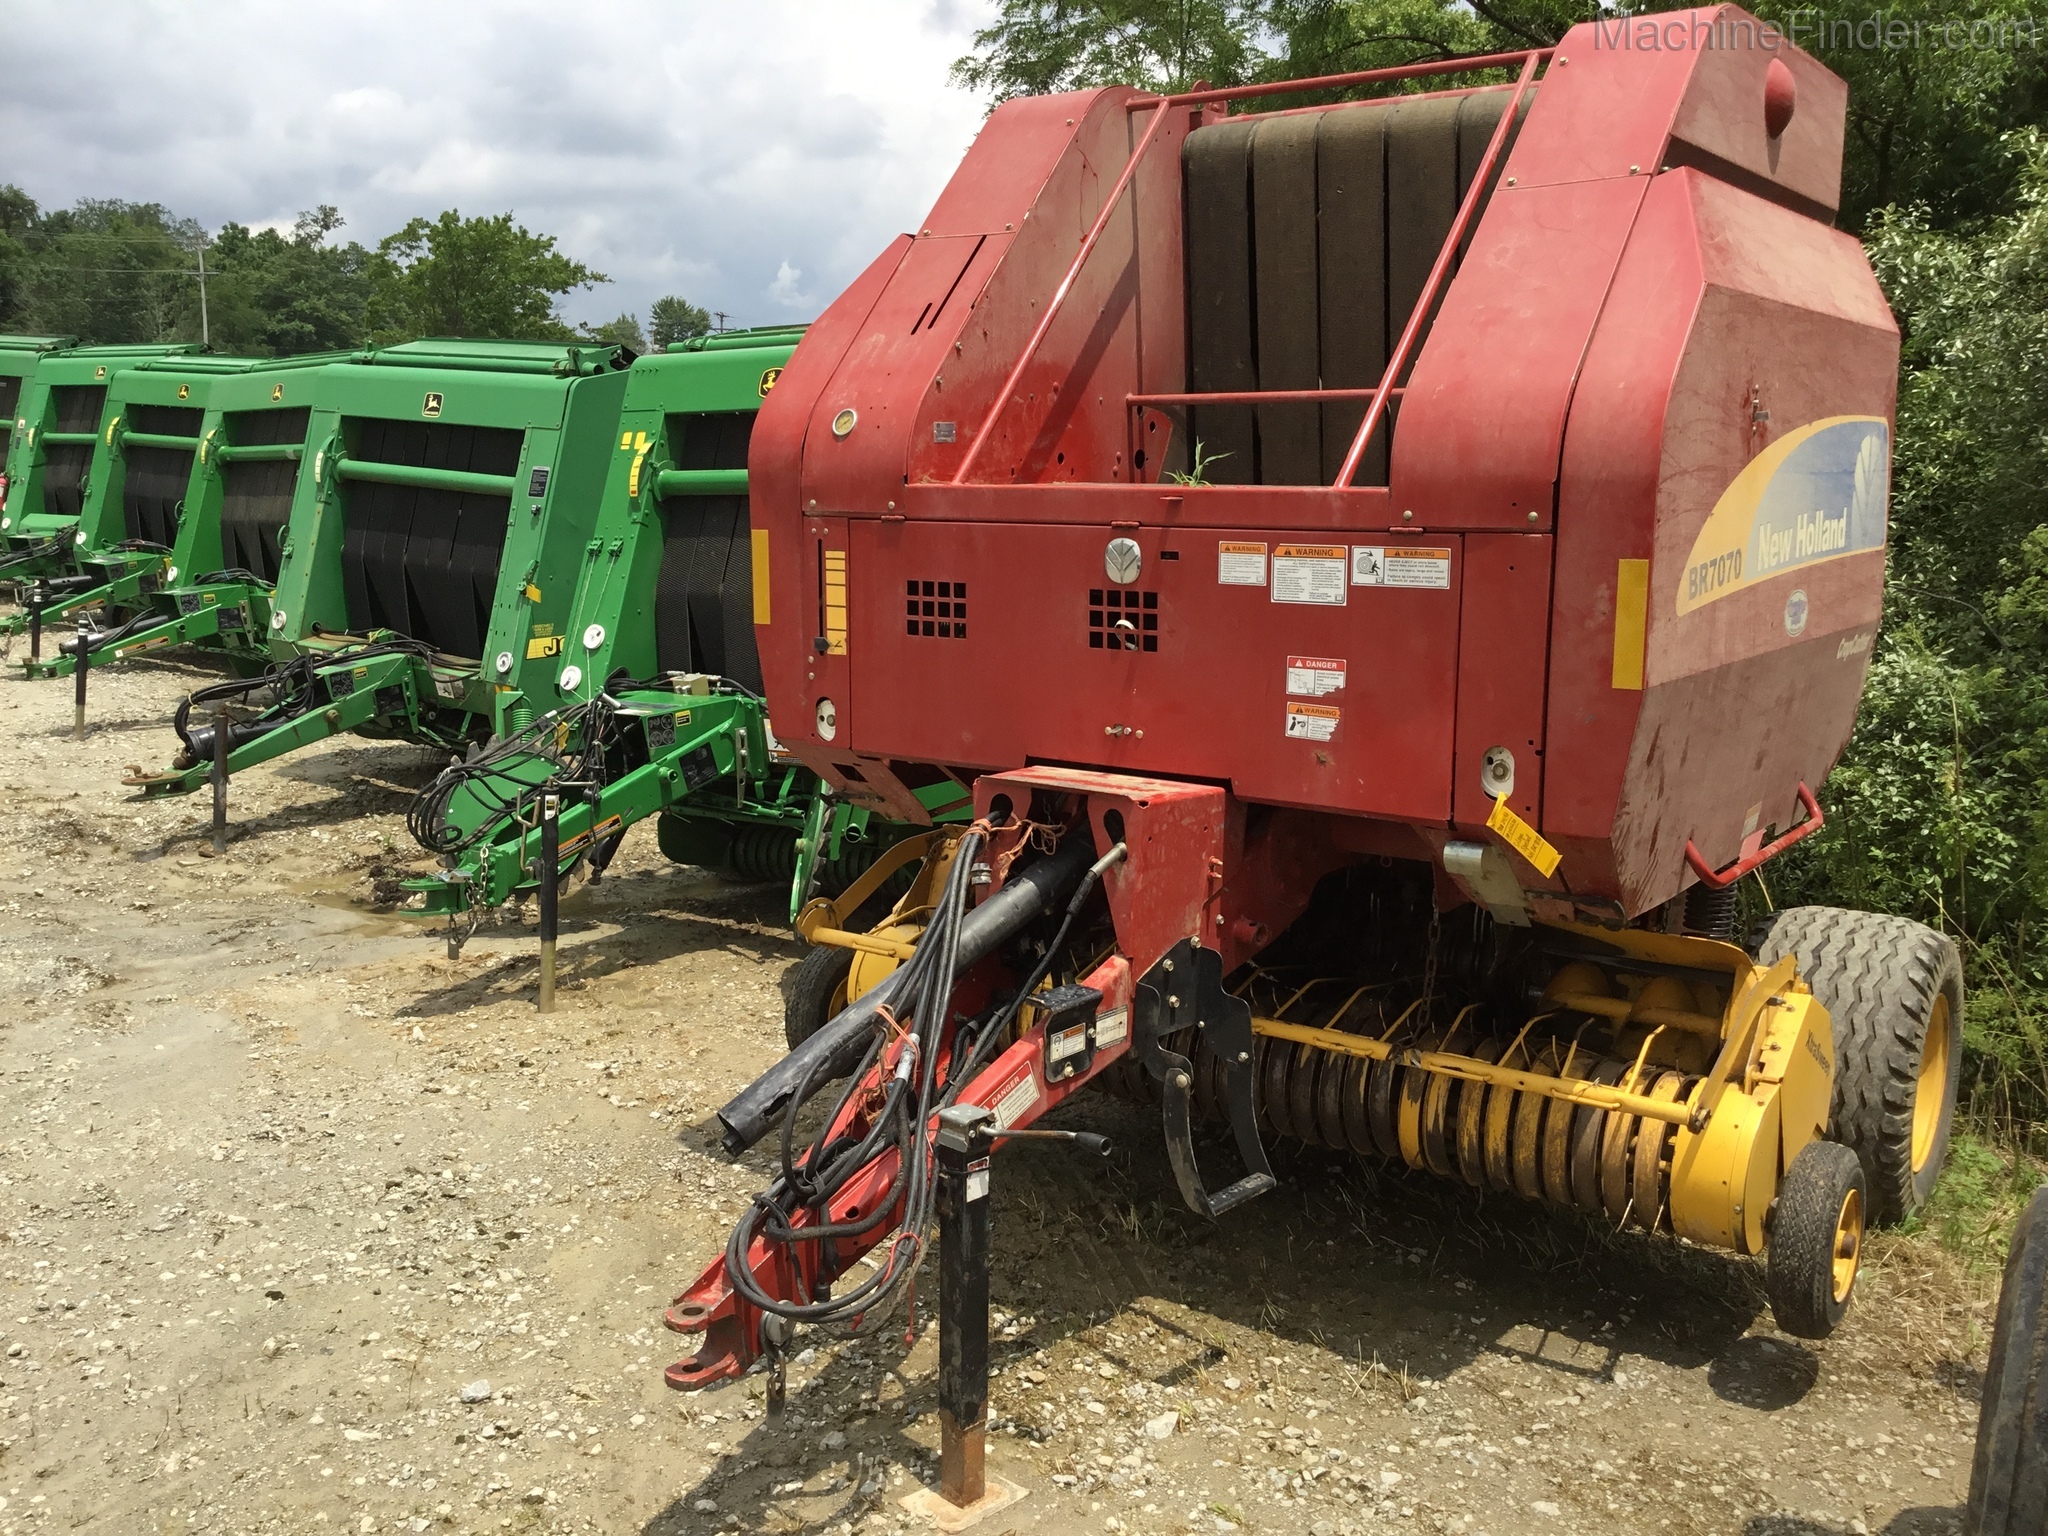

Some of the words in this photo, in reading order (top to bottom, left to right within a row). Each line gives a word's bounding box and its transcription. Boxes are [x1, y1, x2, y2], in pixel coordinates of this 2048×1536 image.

[1295, 548, 1334, 557] WARNING
[1688, 548, 1742, 601] BR7070
[1757, 522, 1792, 571] New
[1796, 507, 1848, 558] Holland
[1305, 661, 1338, 669] DANGER
[1304, 707, 1337, 716] WARNING
[991, 1075, 1021, 1105] DANGER
